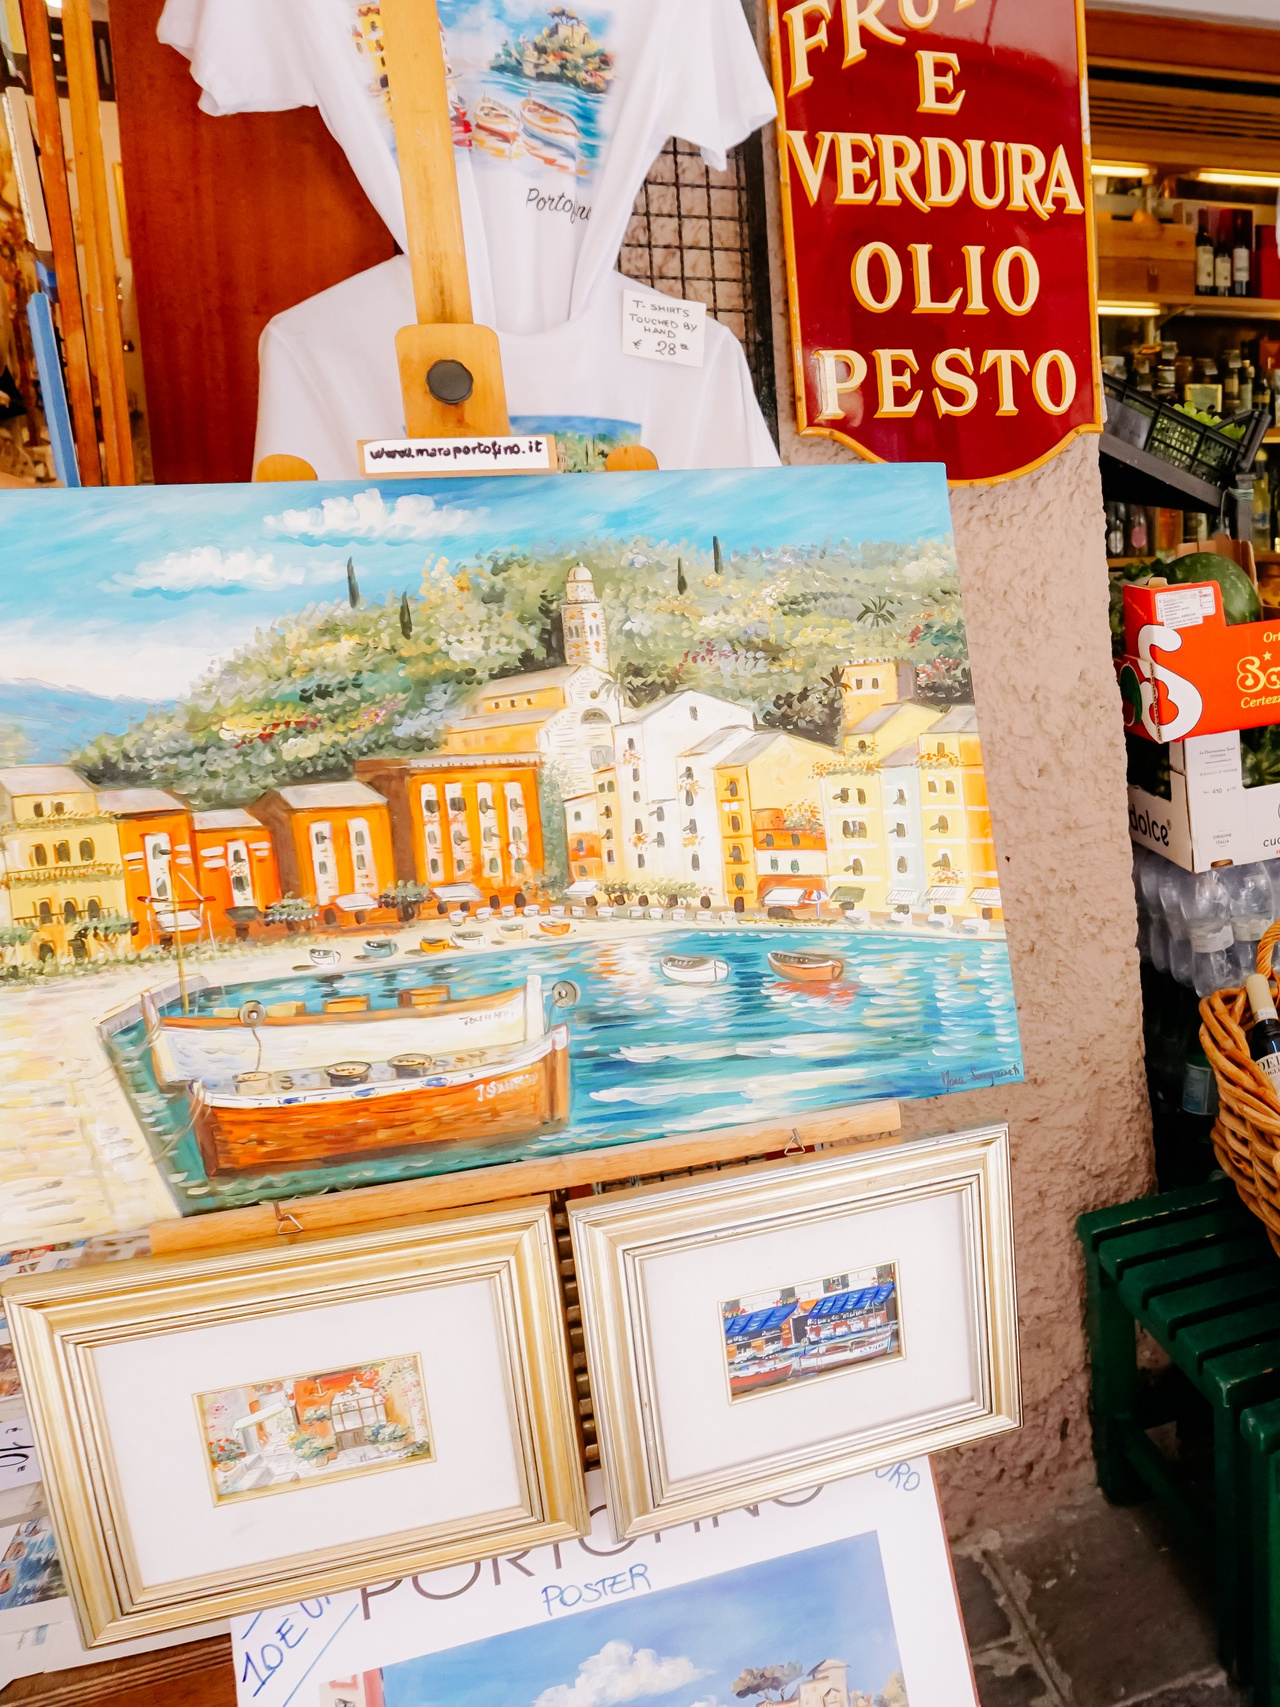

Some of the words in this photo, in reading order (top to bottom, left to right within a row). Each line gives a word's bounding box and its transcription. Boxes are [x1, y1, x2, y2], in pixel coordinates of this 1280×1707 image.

[915, 50, 966, 115] E
[786, 130, 1085, 220] VERDURA
[851, 241, 1040, 316] OLIO
[629, 313, 679, 329] TOUCHED
[683, 323, 698, 332] BY
[644, 326, 677, 339] HAND
[815, 347, 1077, 419] PESTO
[1212, 832, 1232, 840] ORIGINE
[541, 1563, 654, 1616] POSTER
